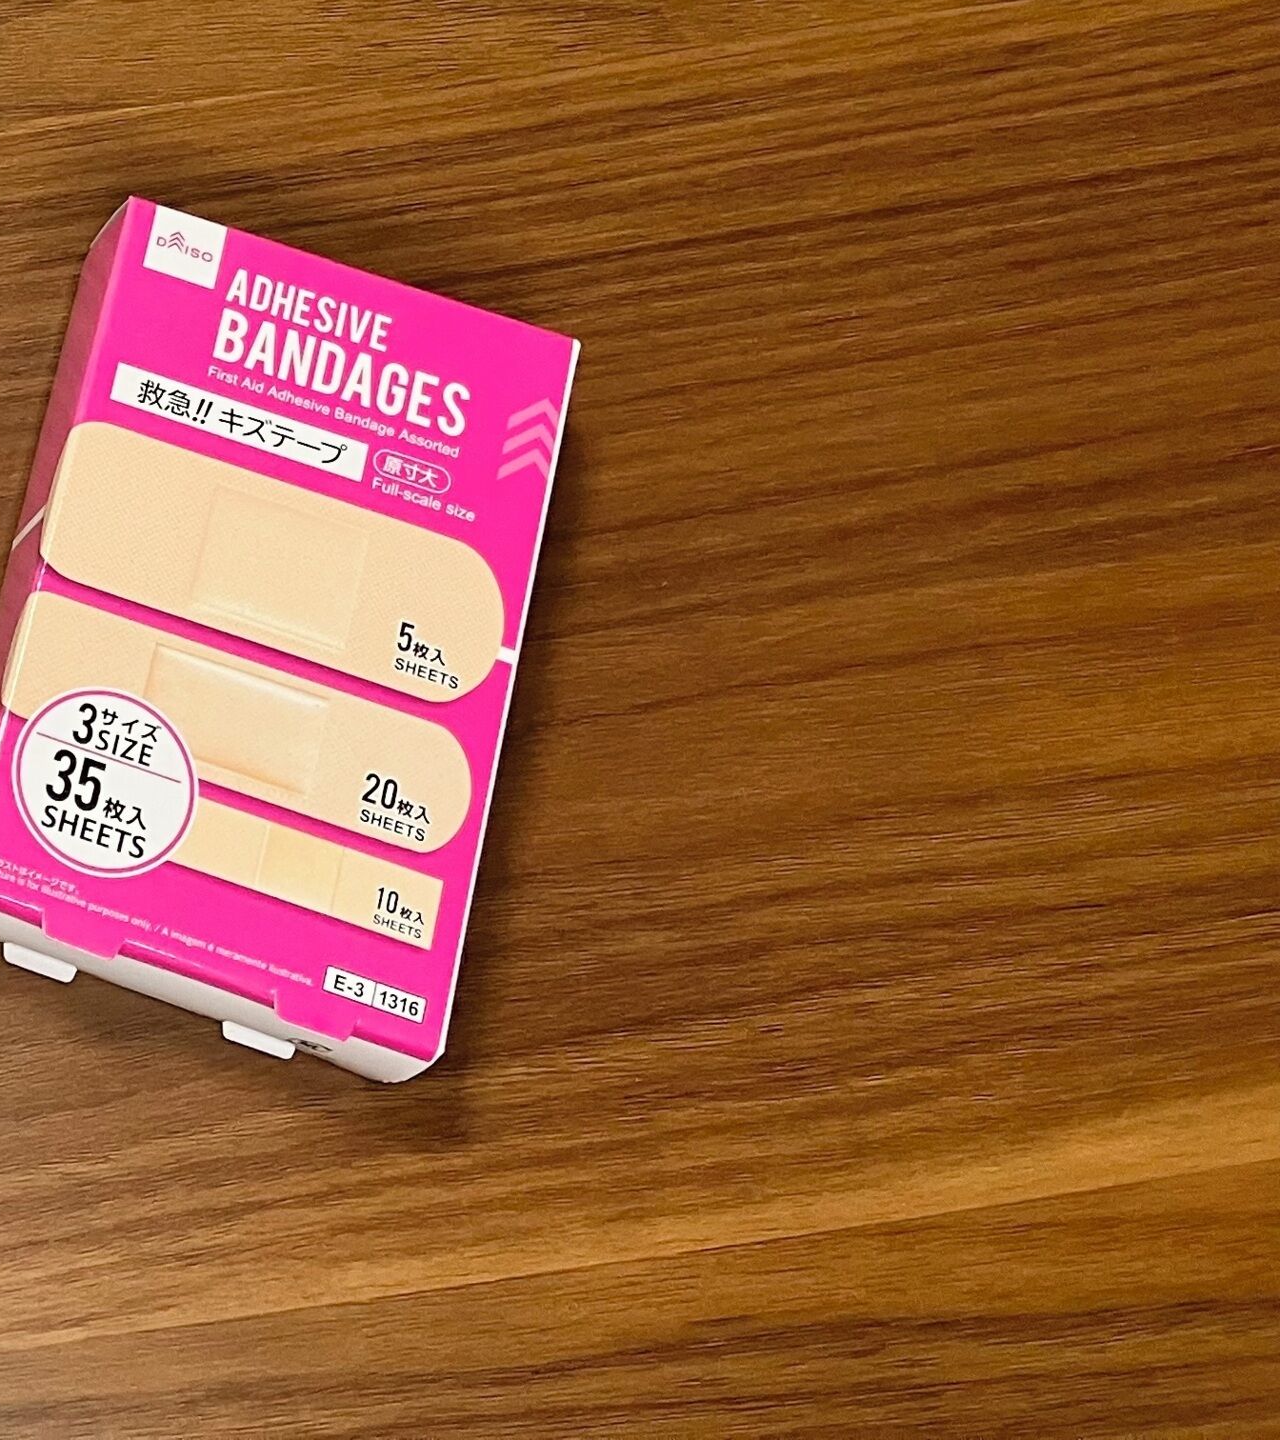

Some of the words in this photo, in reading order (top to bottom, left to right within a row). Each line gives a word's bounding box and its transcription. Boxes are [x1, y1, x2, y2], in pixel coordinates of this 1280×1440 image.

[225, 268, 393, 353] ADHESIVE
[212, 308, 471, 437] BANDAGES
[207, 365, 239, 386] First
[240, 376, 265, 394] Aid
[267, 385, 330, 416] Adhesive
[334, 406, 395, 437] Bandage
[397, 428, 461, 459] Assorted
[382, 455, 439, 489] 原寸大
[371, 477, 442, 511] Full-scale
[445, 501, 476, 523] size
[397, 621, 446, 667] 5枚入
[394, 657, 459, 690] SHEETS
[95, 729, 154, 767] SIZE
[45, 748, 147, 831] 35枚入
[361, 772, 430, 825] 20枚入
[41, 805, 147, 859] SHEETS
[359, 808, 426, 842] SHEETS
[373, 913, 423, 940] SHEETS
[376, 886, 425, 926] 10枚入
[333, 974, 365, 998] E-3
[379, 990, 420, 1017] 1316
